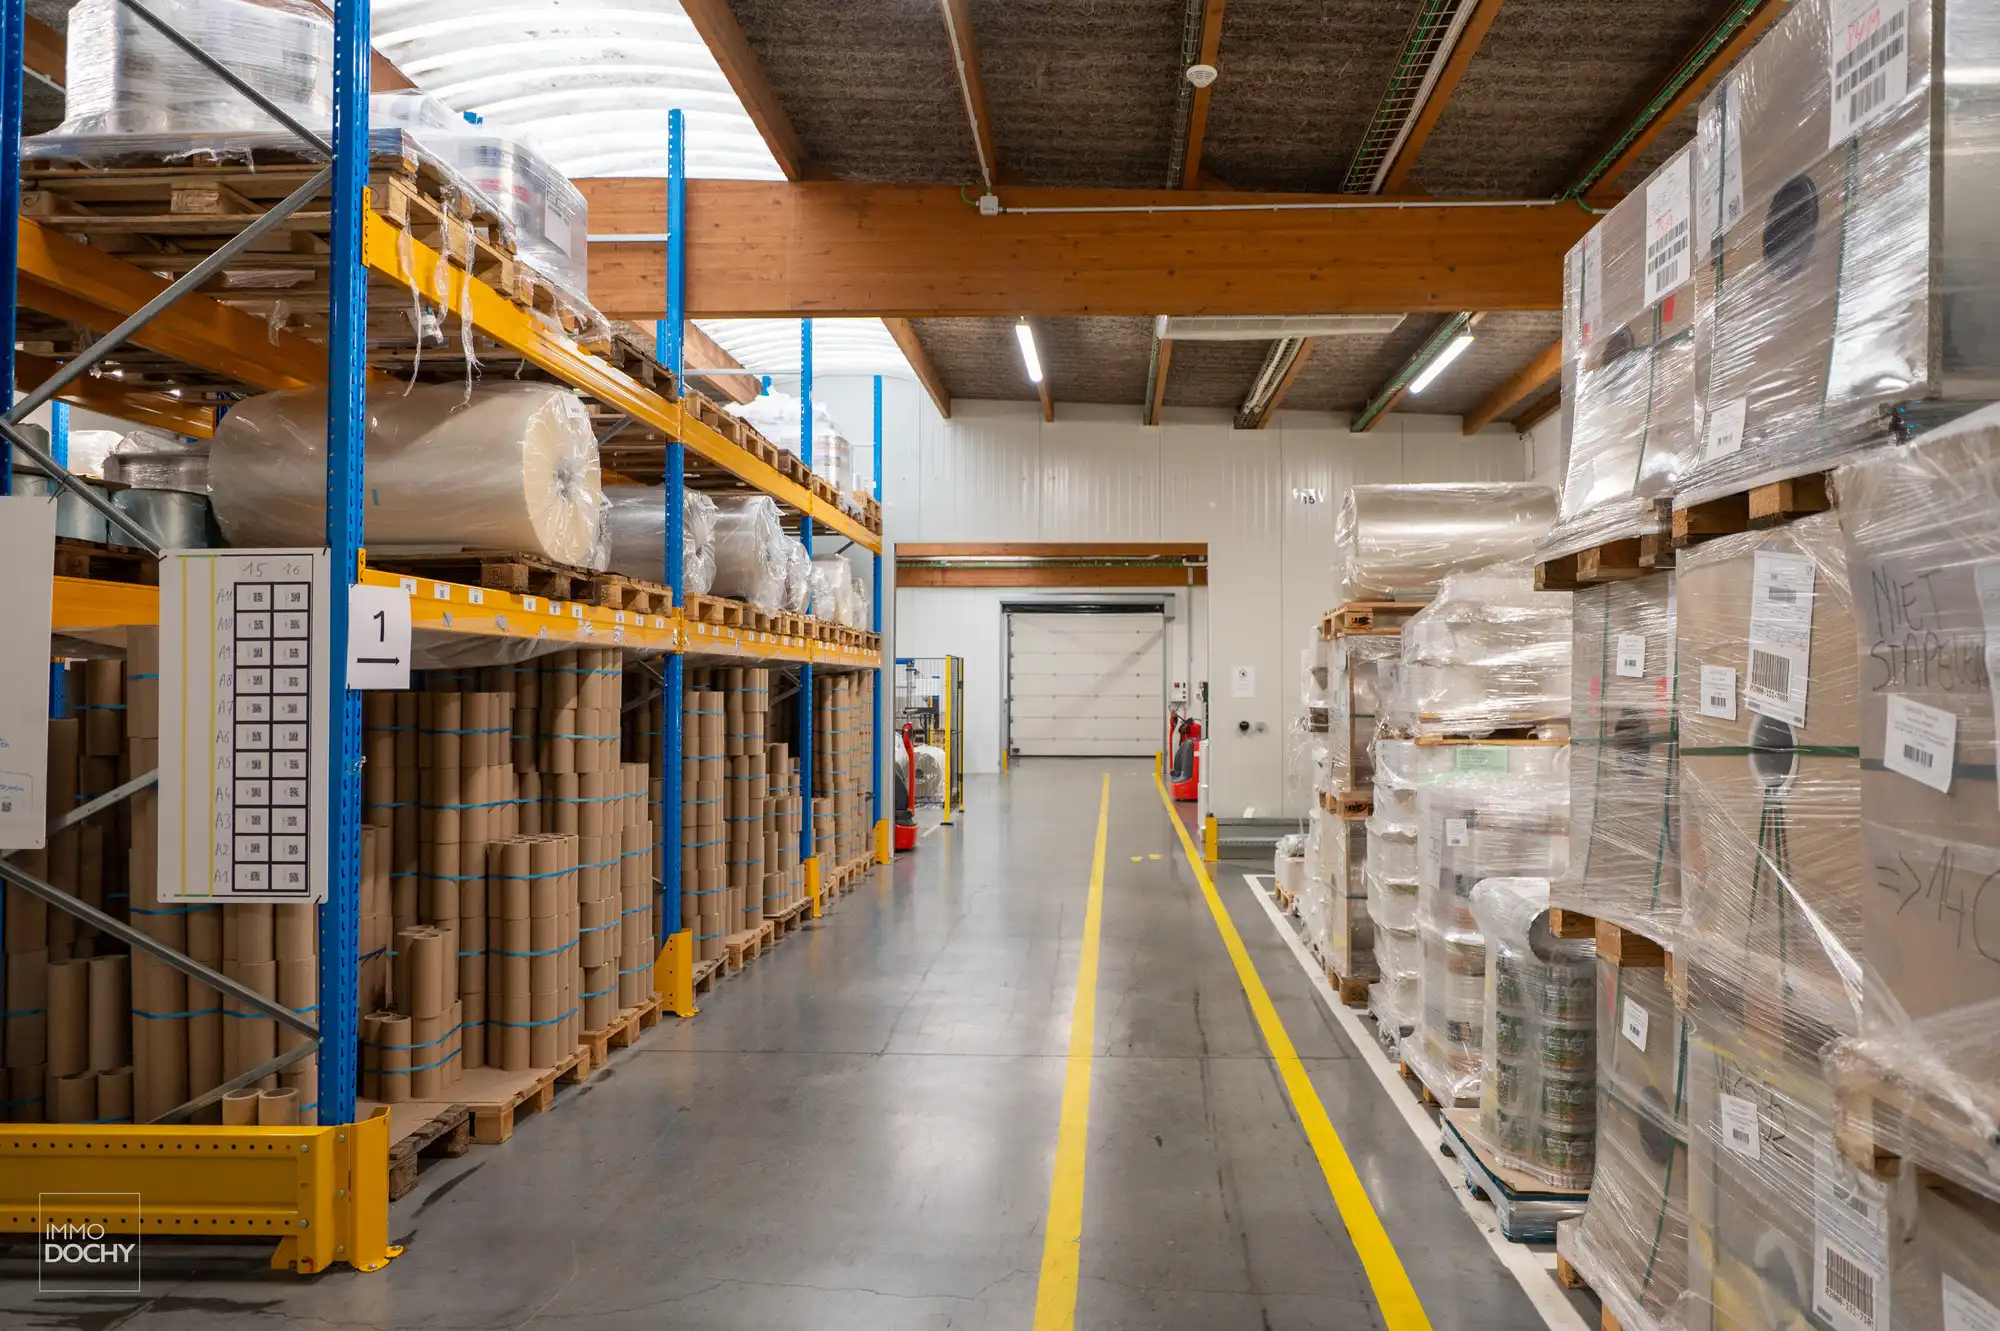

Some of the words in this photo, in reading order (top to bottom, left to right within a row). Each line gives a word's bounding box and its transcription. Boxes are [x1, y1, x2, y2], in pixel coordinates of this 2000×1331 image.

[241, 562, 268, 577] 15
[281, 563, 301, 575] 16
[1872, 565, 1942, 638] NIET
[373, 610, 385, 642] 1
[219, 673, 233, 687] A8
[218, 700, 234, 716] A7
[216, 729, 230, 744] A6
[217, 756, 232, 770] A5
[215, 787, 230, 803] A4
[215, 812, 231, 829] A3
[215, 842, 229, 856] A2
[214, 868, 229, 884] A1
